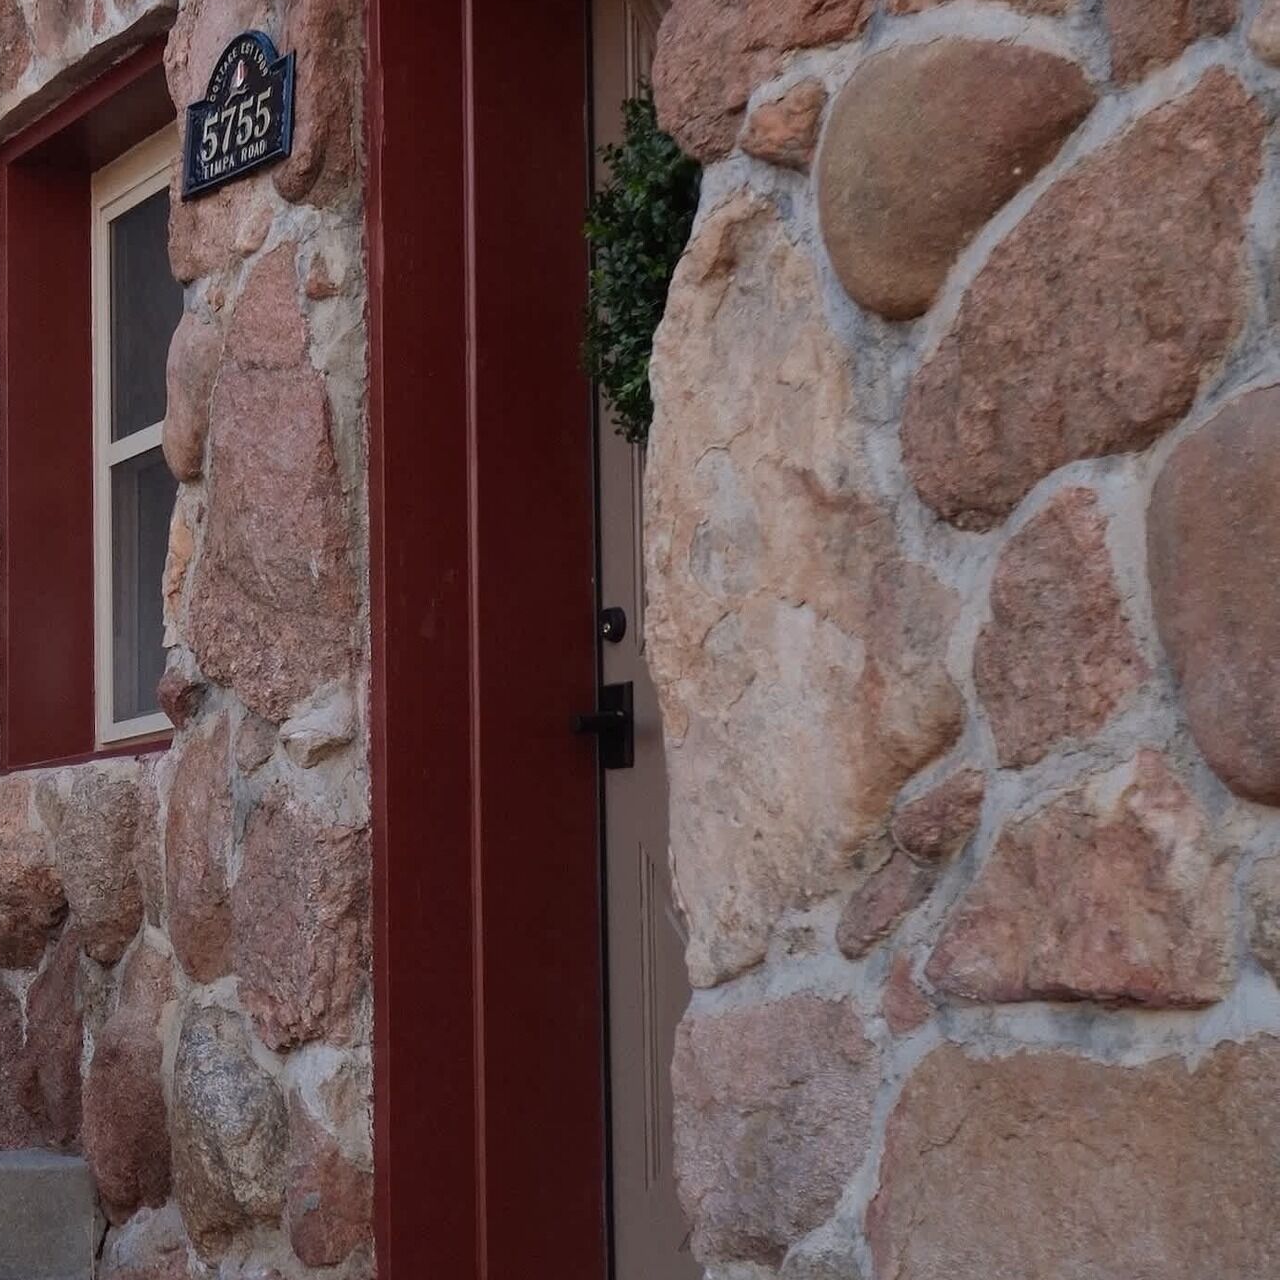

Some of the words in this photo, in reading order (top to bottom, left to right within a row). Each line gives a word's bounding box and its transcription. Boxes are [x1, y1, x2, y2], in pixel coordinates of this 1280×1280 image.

[201, 86, 272, 162] 5755
[201, 153, 235, 180] TIMPA
[241, 139, 266, 163] ROAD
